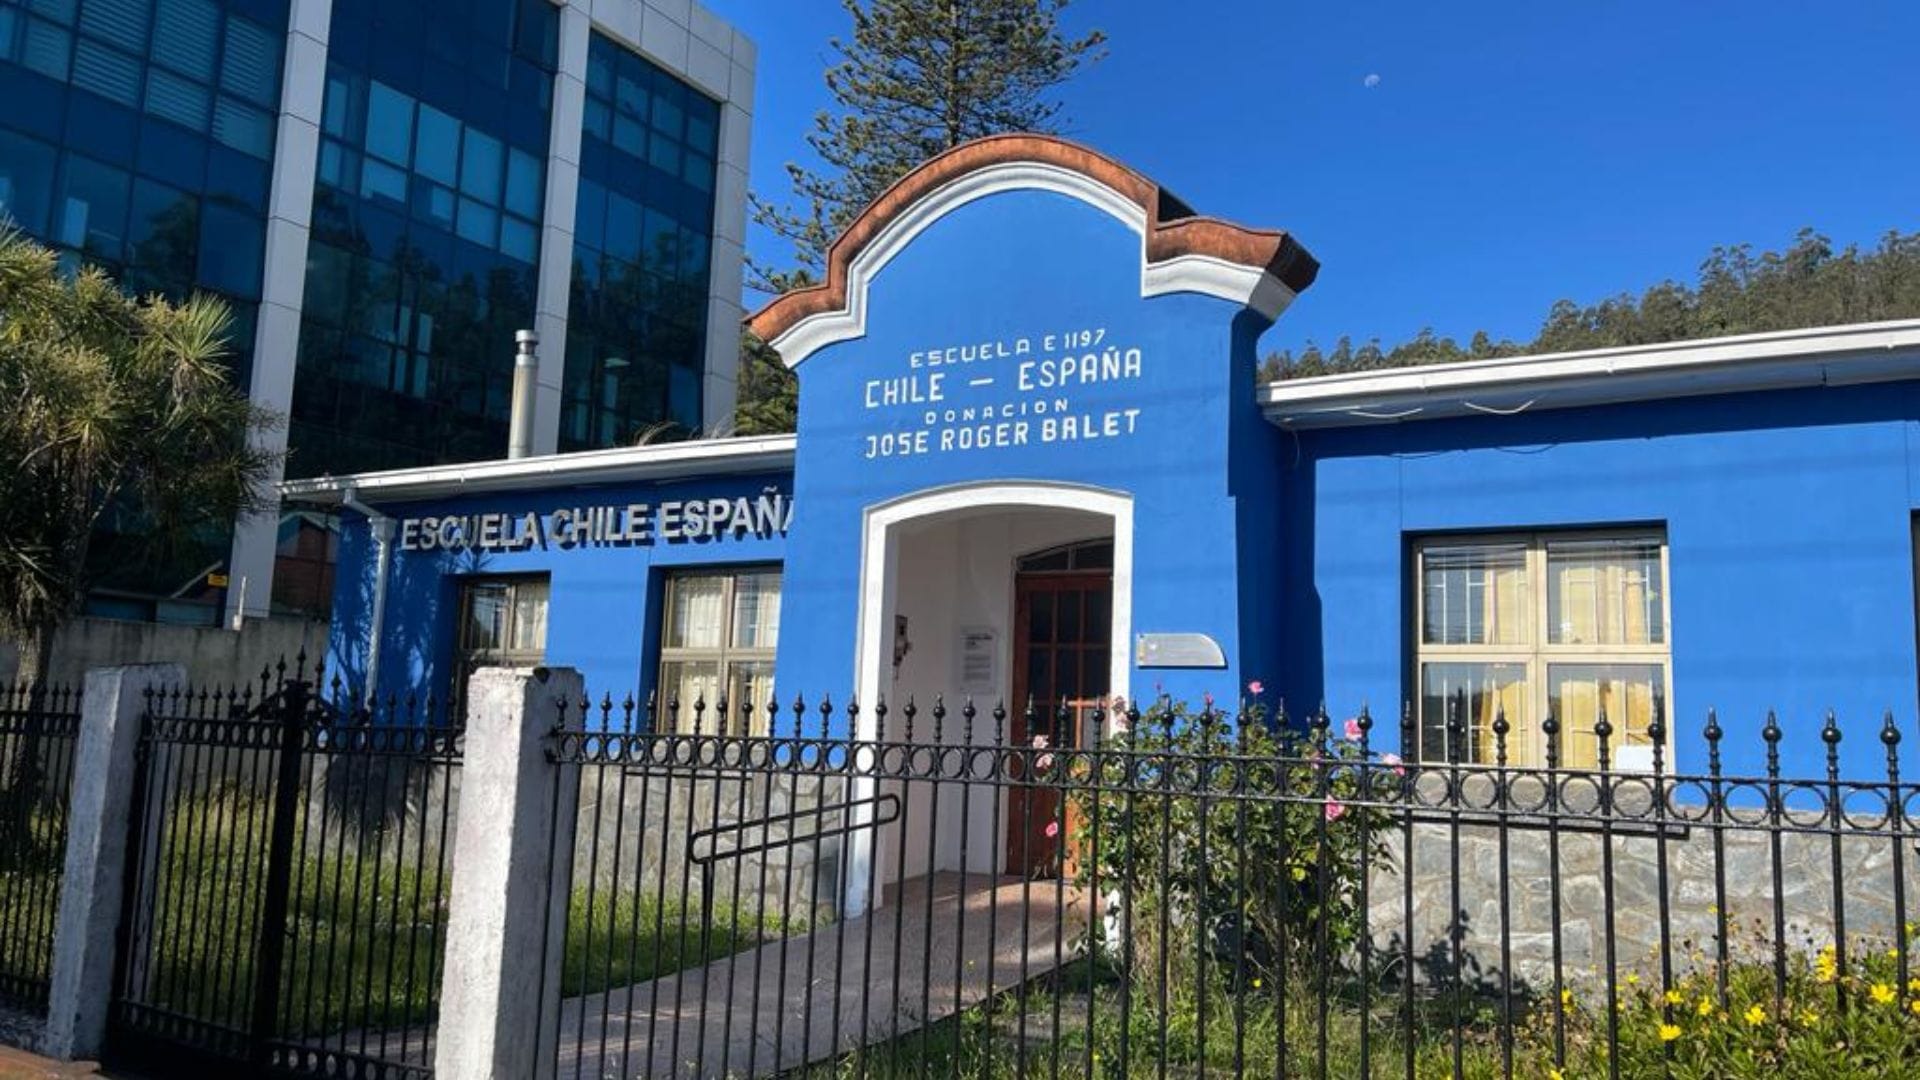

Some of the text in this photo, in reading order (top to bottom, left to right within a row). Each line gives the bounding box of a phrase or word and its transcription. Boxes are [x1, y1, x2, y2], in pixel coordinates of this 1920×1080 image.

[910, 328, 1105, 368] ESCUELA E 1197
[865, 373, 945, 408] CHILE
[1018, 346, 1141, 391] ESPAÑA
[865, 409, 1141, 459] JOSE ROGER BALET
[925, 398, 1068, 425] DONACION
[401, 511, 539, 550] ESCUELA
[551, 503, 648, 543] CHILE
